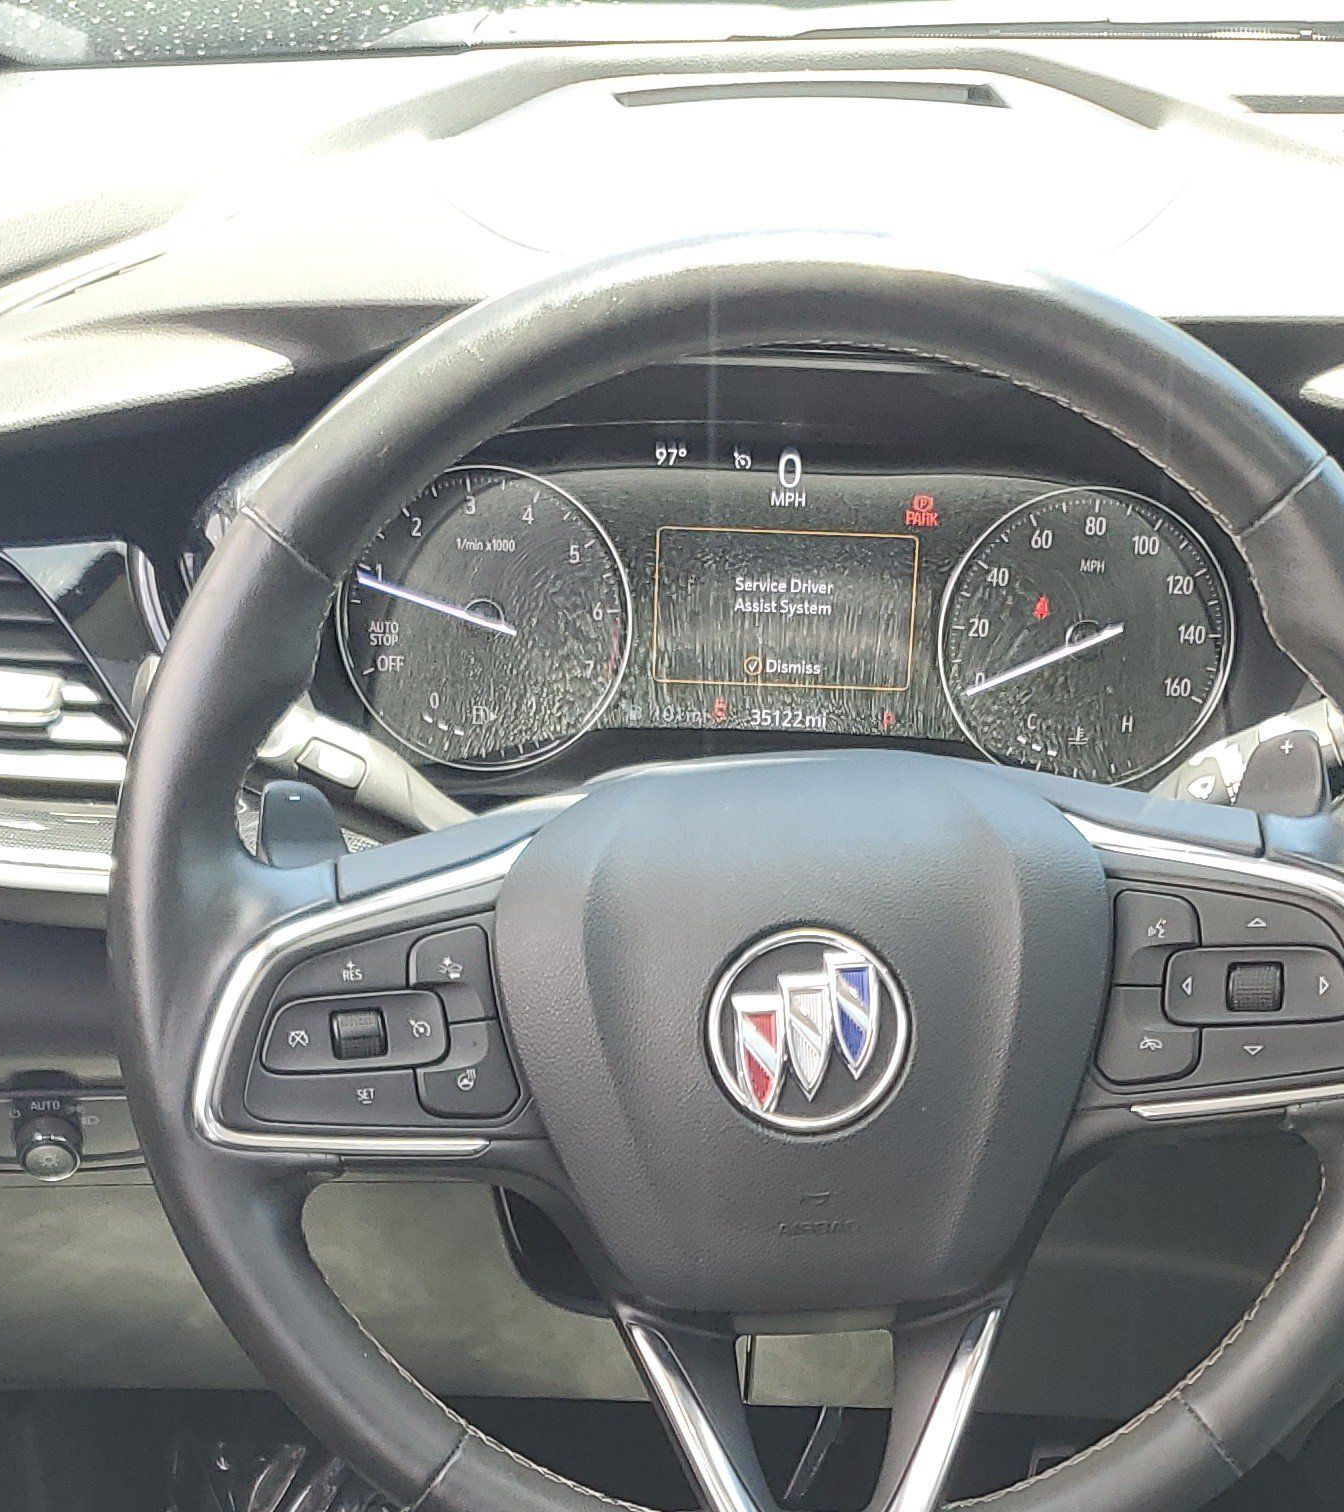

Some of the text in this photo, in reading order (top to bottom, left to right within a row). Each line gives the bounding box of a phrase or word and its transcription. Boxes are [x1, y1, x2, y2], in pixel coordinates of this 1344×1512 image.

[655, 445, 687, 466] 97°
[778, 453, 803, 490] 0
[465, 495, 476, 515] 3
[770, 490, 806, 507] MPH
[522, 505, 534, 525] 4
[411, 517, 422, 537] 2
[1085, 517, 1106, 536] 80
[1031, 530, 1052, 549] 60
[1133, 535, 1160, 555] 100
[569, 545, 581, 564] 5
[375, 563, 383, 582] 1
[1080, 559, 1105, 574] MPH
[735, 576, 834, 594] Service Driver
[987, 568, 1009, 587] 40
[1167, 576, 1194, 596] 120
[592, 602, 603, 621] 6
[734, 597, 832, 618] Assist System
[368, 621, 400, 633] AUTO
[969, 619, 989, 638] 20
[1178, 625, 1206, 645] 140
[369, 633, 400, 647] STOP
[377, 655, 405, 672] OFF
[766, 660, 822, 675] Dismiss
[1164, 678, 1191, 698] 160
[429, 692, 439, 709] 0
[751, 710, 804, 728] 35122
[1027, 714, 1038, 731] C
[1122, 715, 1134, 732] H
[343, 969, 363, 981] RES
[357, 1088, 375, 1101] SET
[30, 1100, 60, 1112] AUTO
